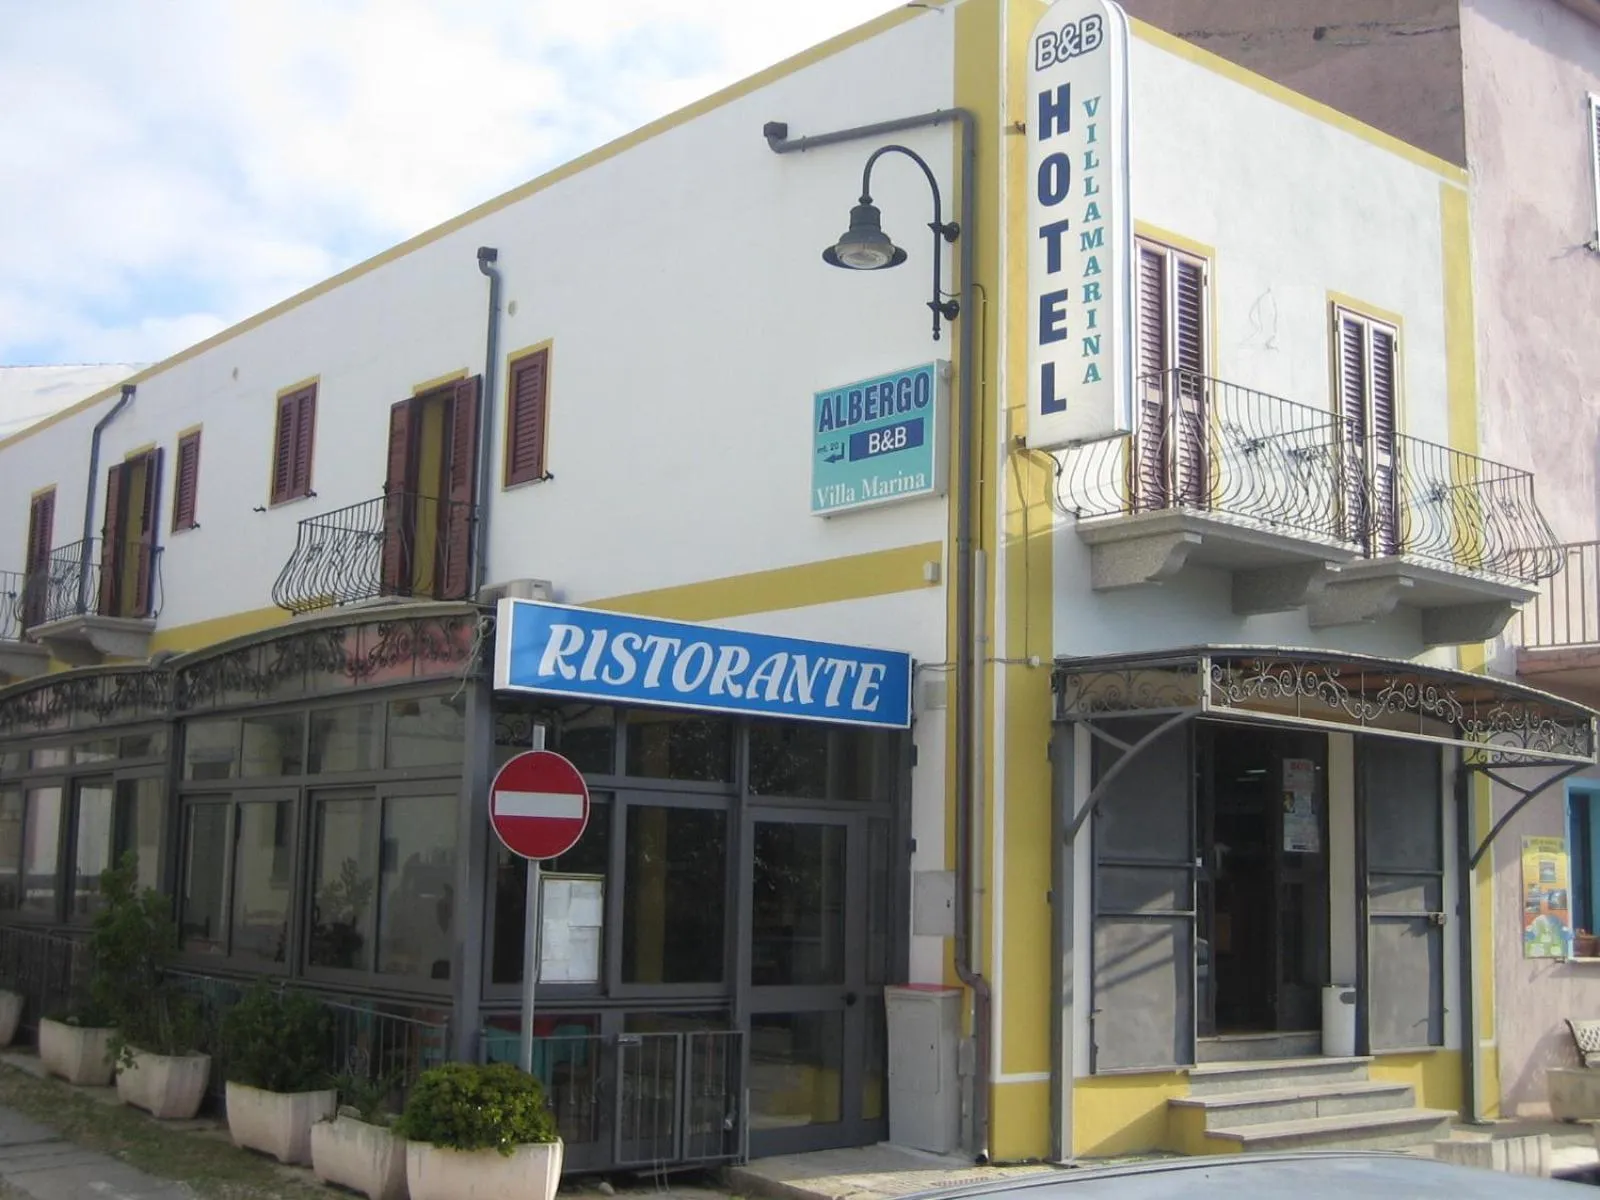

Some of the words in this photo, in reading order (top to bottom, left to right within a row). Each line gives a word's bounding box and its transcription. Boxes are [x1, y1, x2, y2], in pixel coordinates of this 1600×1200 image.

[1035, 14, 1103, 71] B&B
[1037, 82, 1071, 416] HOTEL
[818, 371, 930, 433] ALBERGO
[867, 425, 907, 454] B&B
[816, 482, 856, 508] Villa
[861, 470, 926, 500] Marina
[538, 623, 888, 713] RISTORANTE
